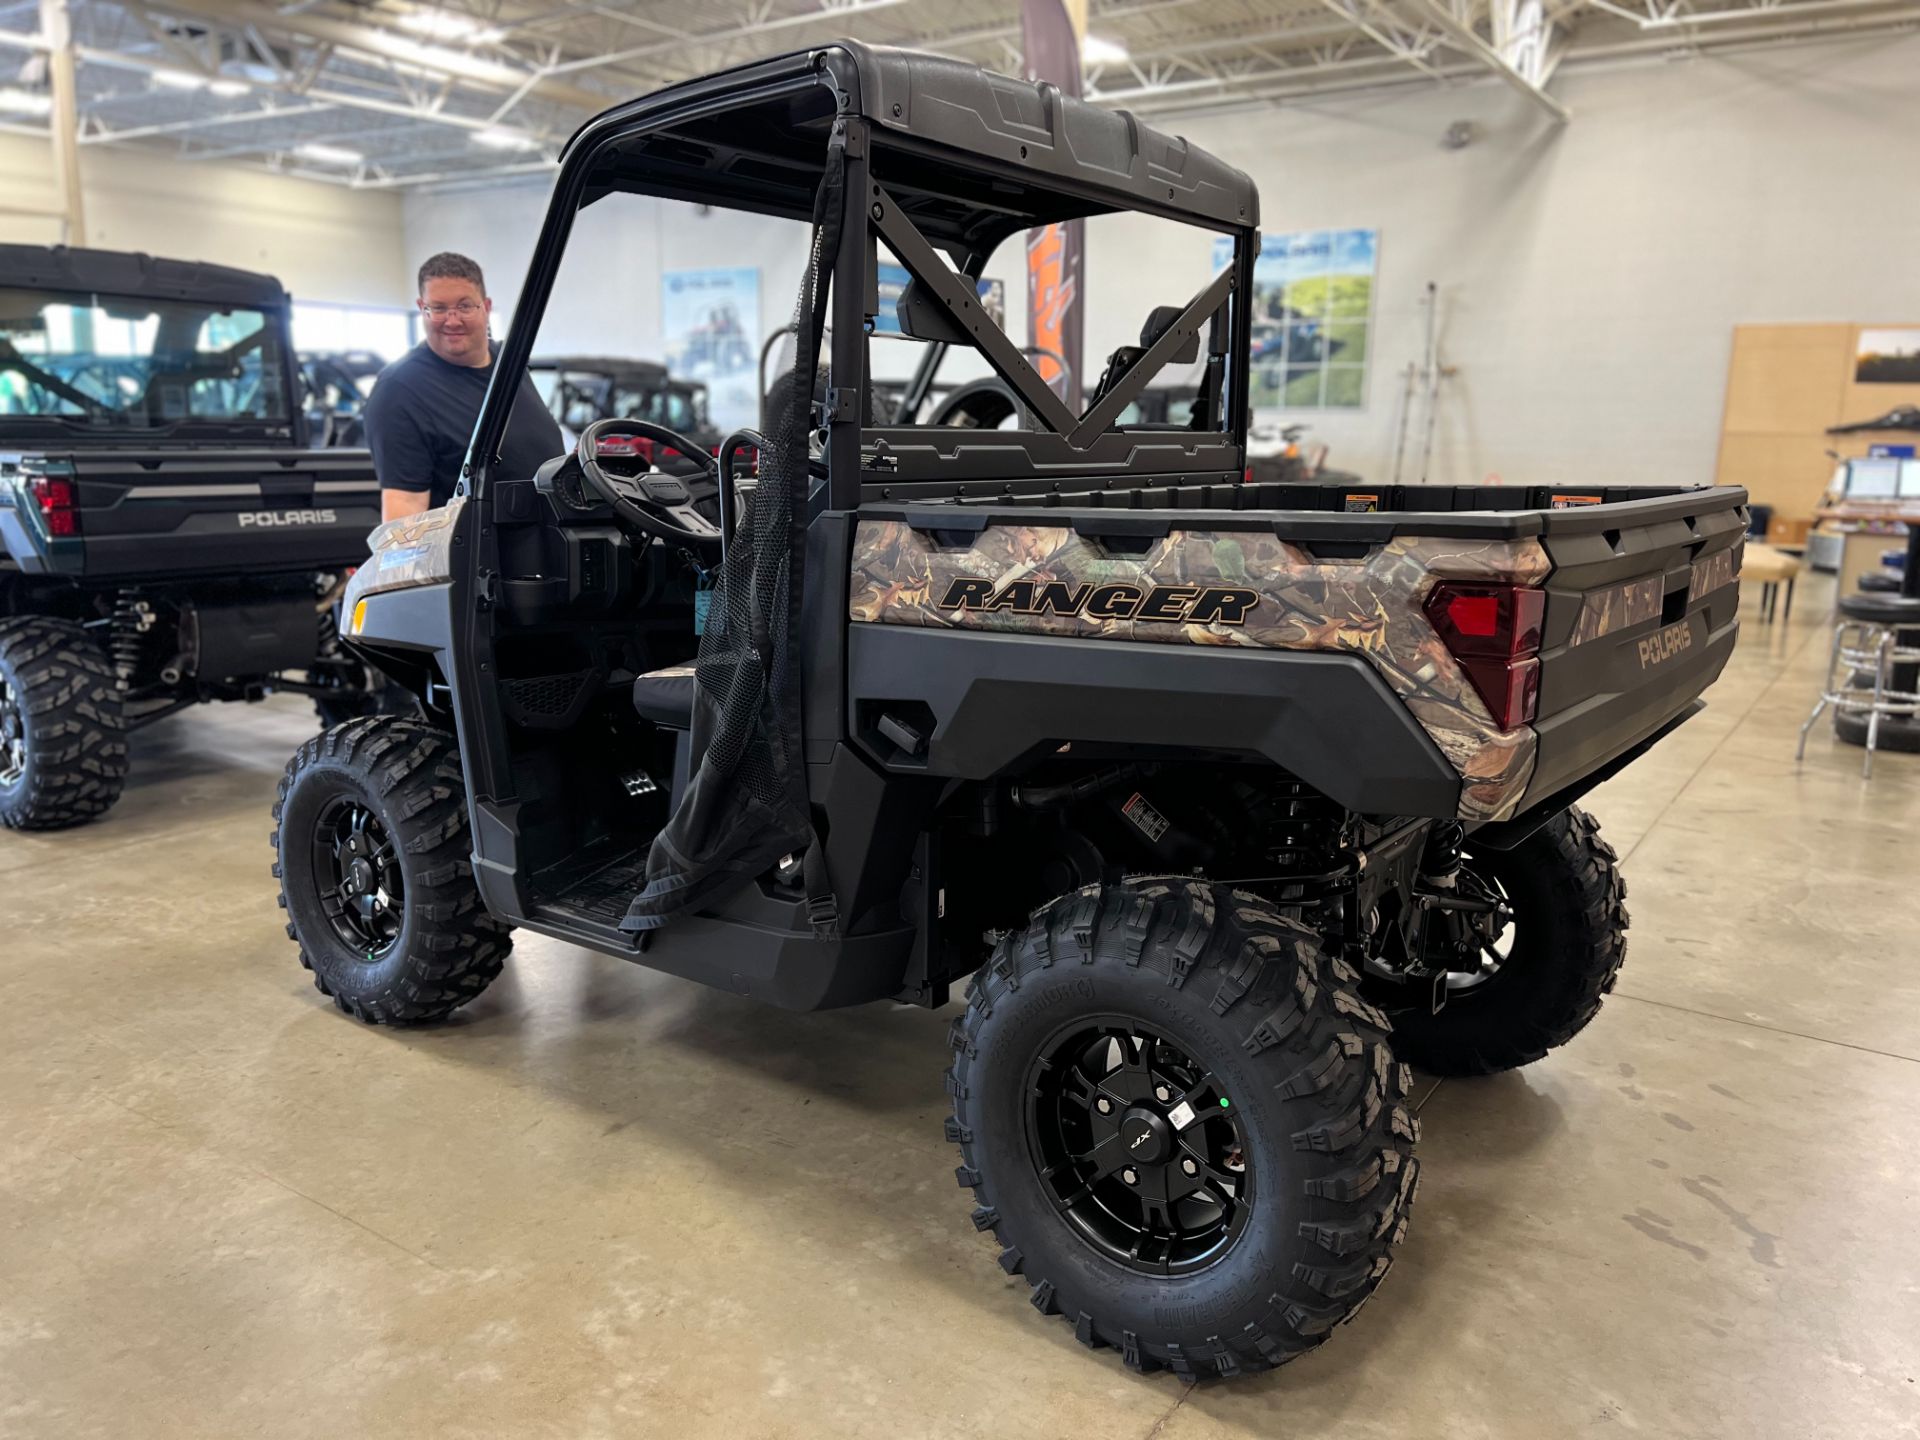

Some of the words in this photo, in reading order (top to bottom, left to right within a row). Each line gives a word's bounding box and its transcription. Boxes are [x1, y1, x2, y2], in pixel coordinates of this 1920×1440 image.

[238, 509, 337, 528] POLARIS
[376, 515, 451, 549] XP
[938, 575, 1259, 626] RANGER
[1638, 621, 1691, 669] POLARIS
[1130, 1129, 1151, 1149] XP
